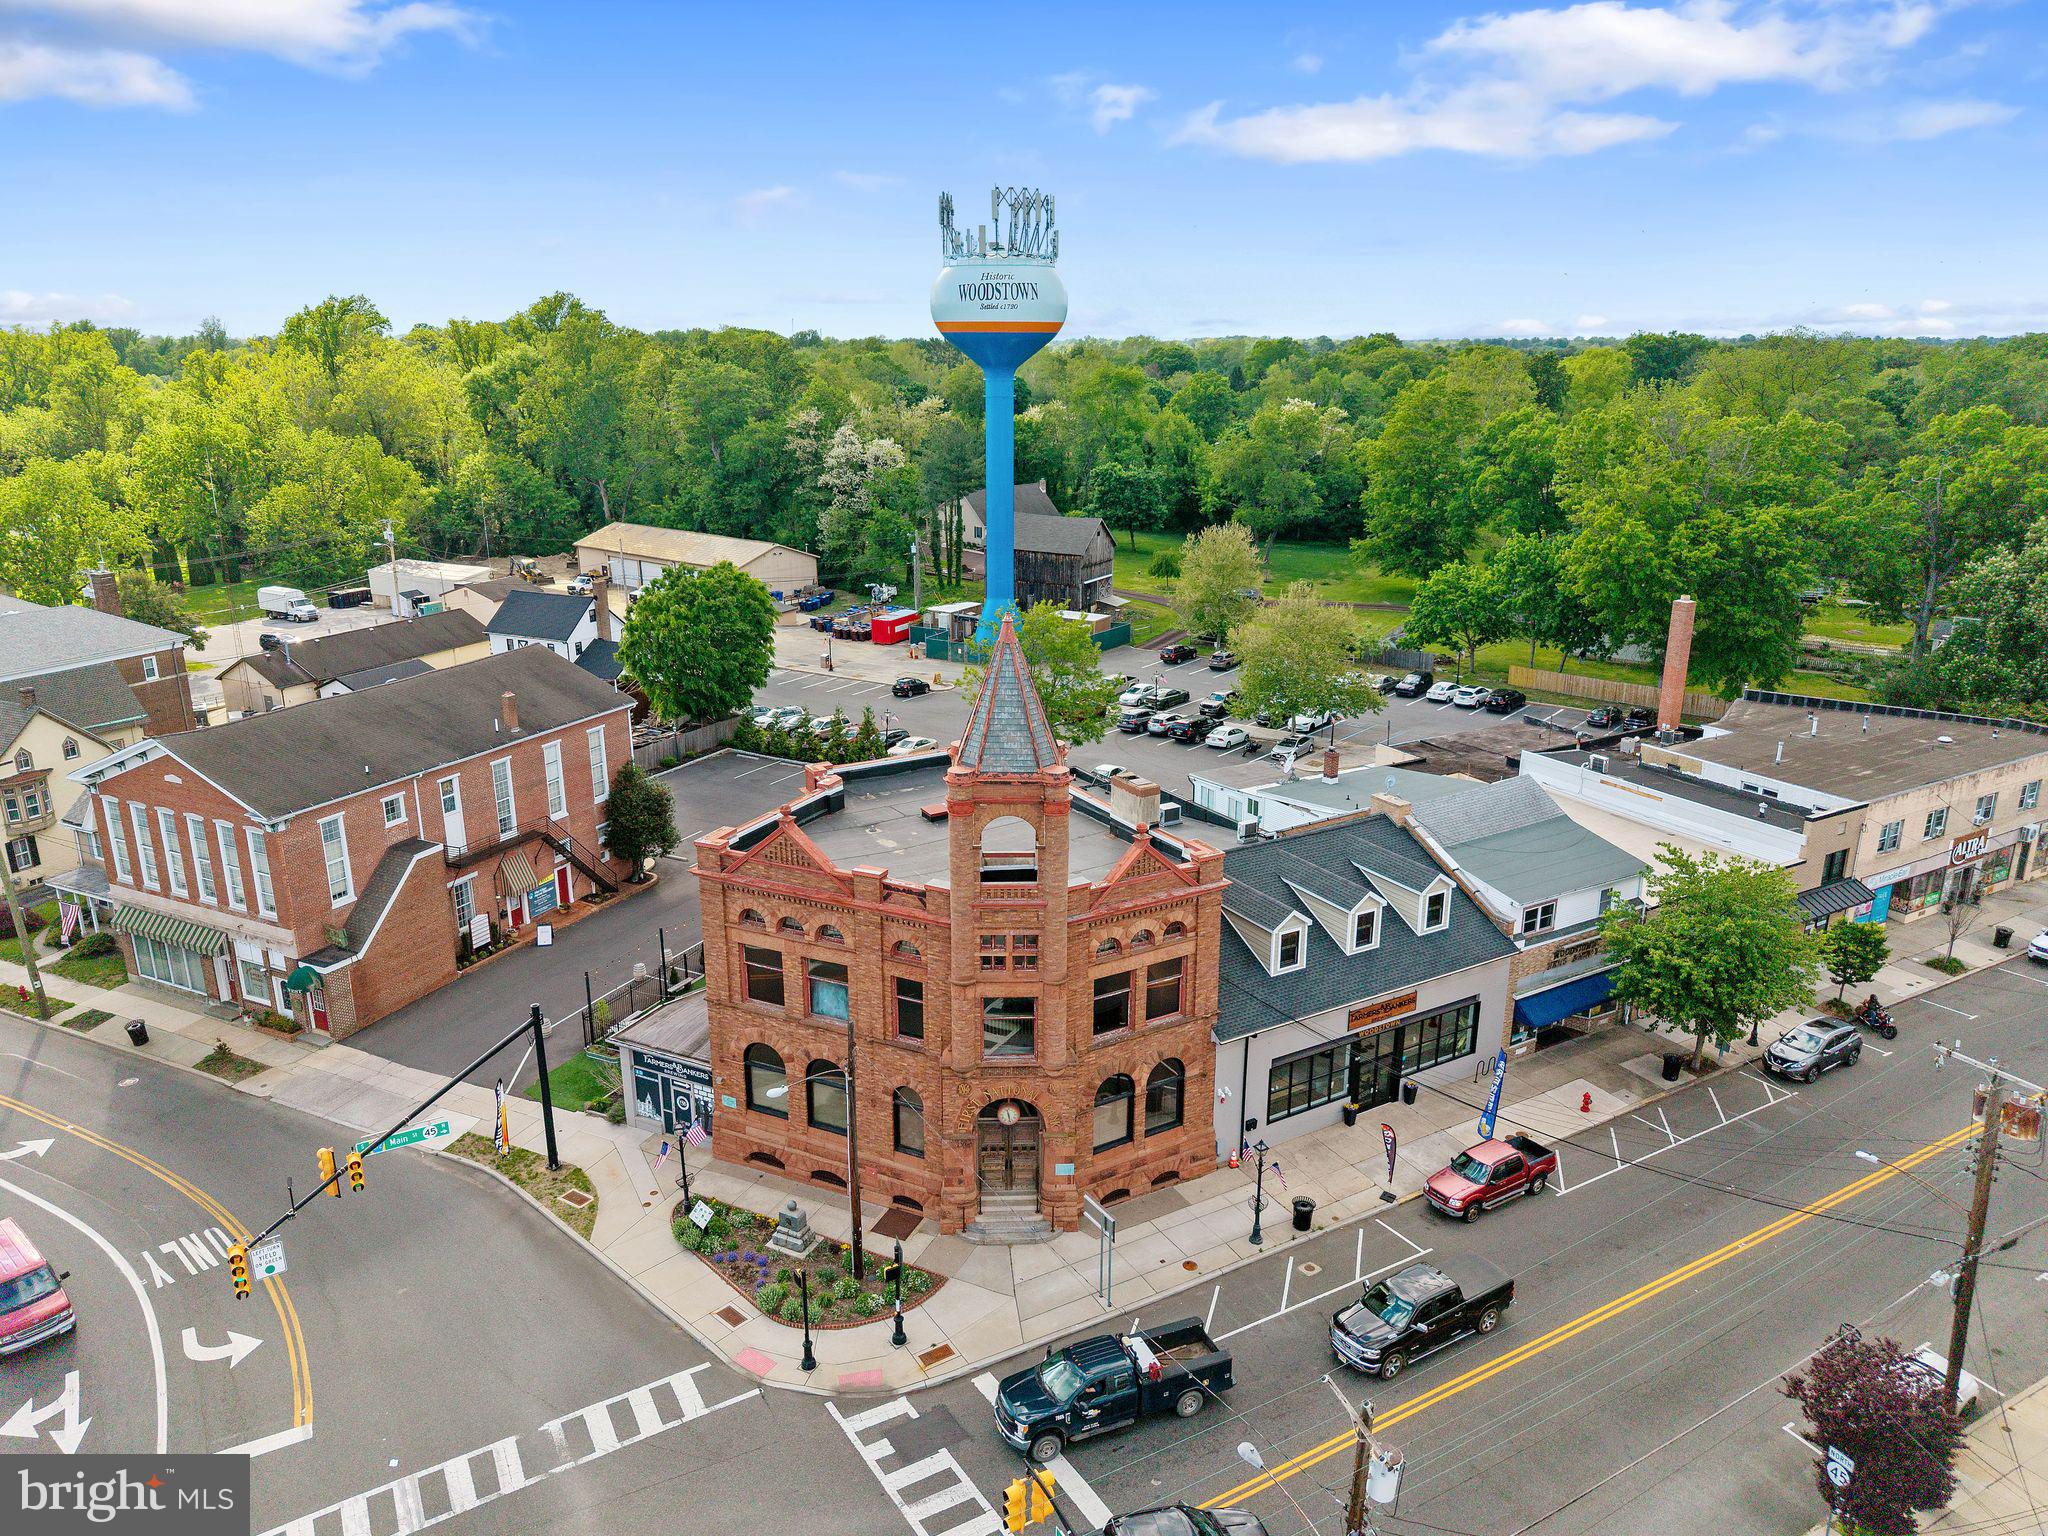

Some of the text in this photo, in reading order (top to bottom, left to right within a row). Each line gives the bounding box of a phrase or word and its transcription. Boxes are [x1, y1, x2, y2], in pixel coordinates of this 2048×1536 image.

[980, 272, 1015, 281] Historic
[958, 282, 1039, 302] WOODSTOWN
[979, 302, 999, 311] Settled
[1359, 1019, 1401, 1038] WOODSTOWN
[643, 1054, 674, 1071] FARMERS
[677, 1063, 709, 1080] BANKERS
[957, 1098, 980, 1132] FIRST
[983, 1084, 1041, 1102] NATIONAL
[389, 1135, 409, 1147] Main
[424, 1127, 437, 1136] 45
[141, 1227, 233, 1288] ONLY
[252, 1248, 265, 1257] LEFT
[258, 1251, 277, 1261] YIELD
[1830, 1467, 1848, 1486] 45
